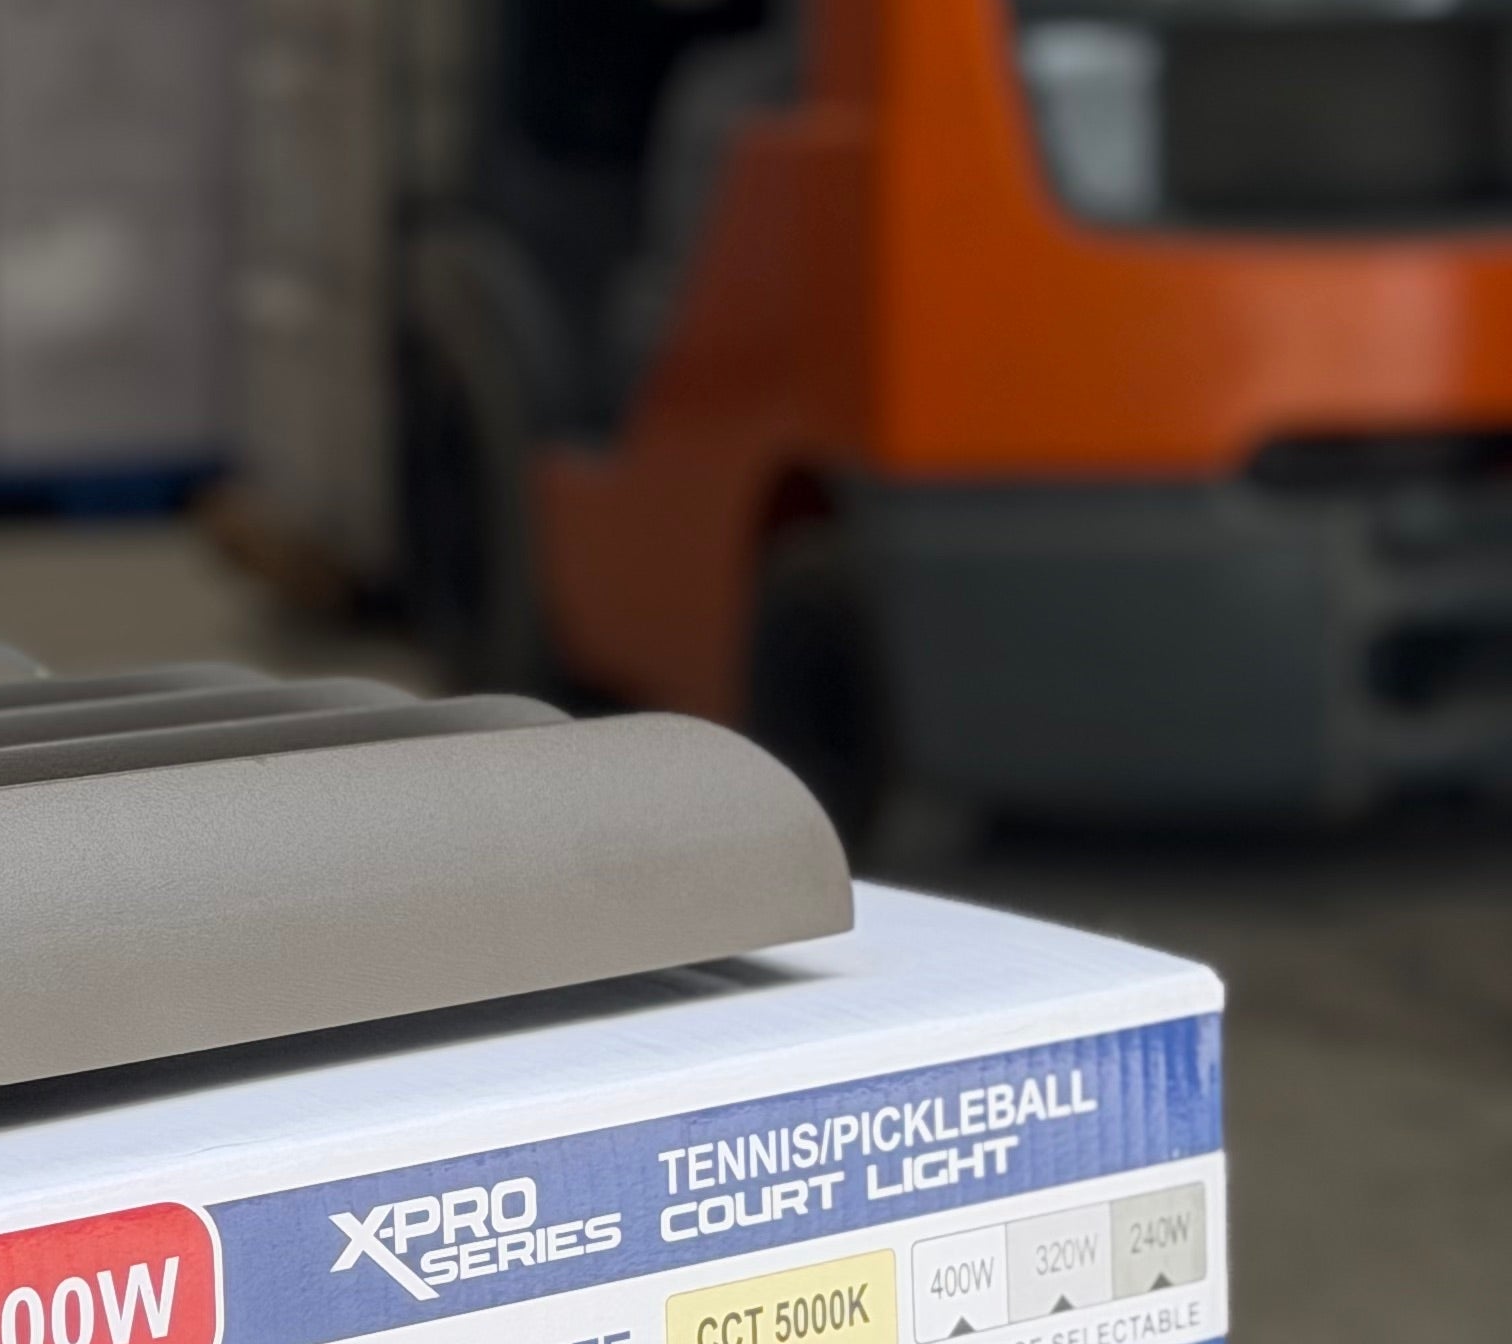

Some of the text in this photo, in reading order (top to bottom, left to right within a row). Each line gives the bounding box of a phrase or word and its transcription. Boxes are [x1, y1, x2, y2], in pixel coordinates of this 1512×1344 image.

[658, 1070, 1097, 1195] TENNIS/PICKLEBALL
[660, 1136, 1020, 1243] COURT LIGHT
[420, 1212, 622, 1286] SERIES
[930, 1212, 1191, 1300] 400W 320W 240W
[775, 1283, 870, 1342] 5000K
